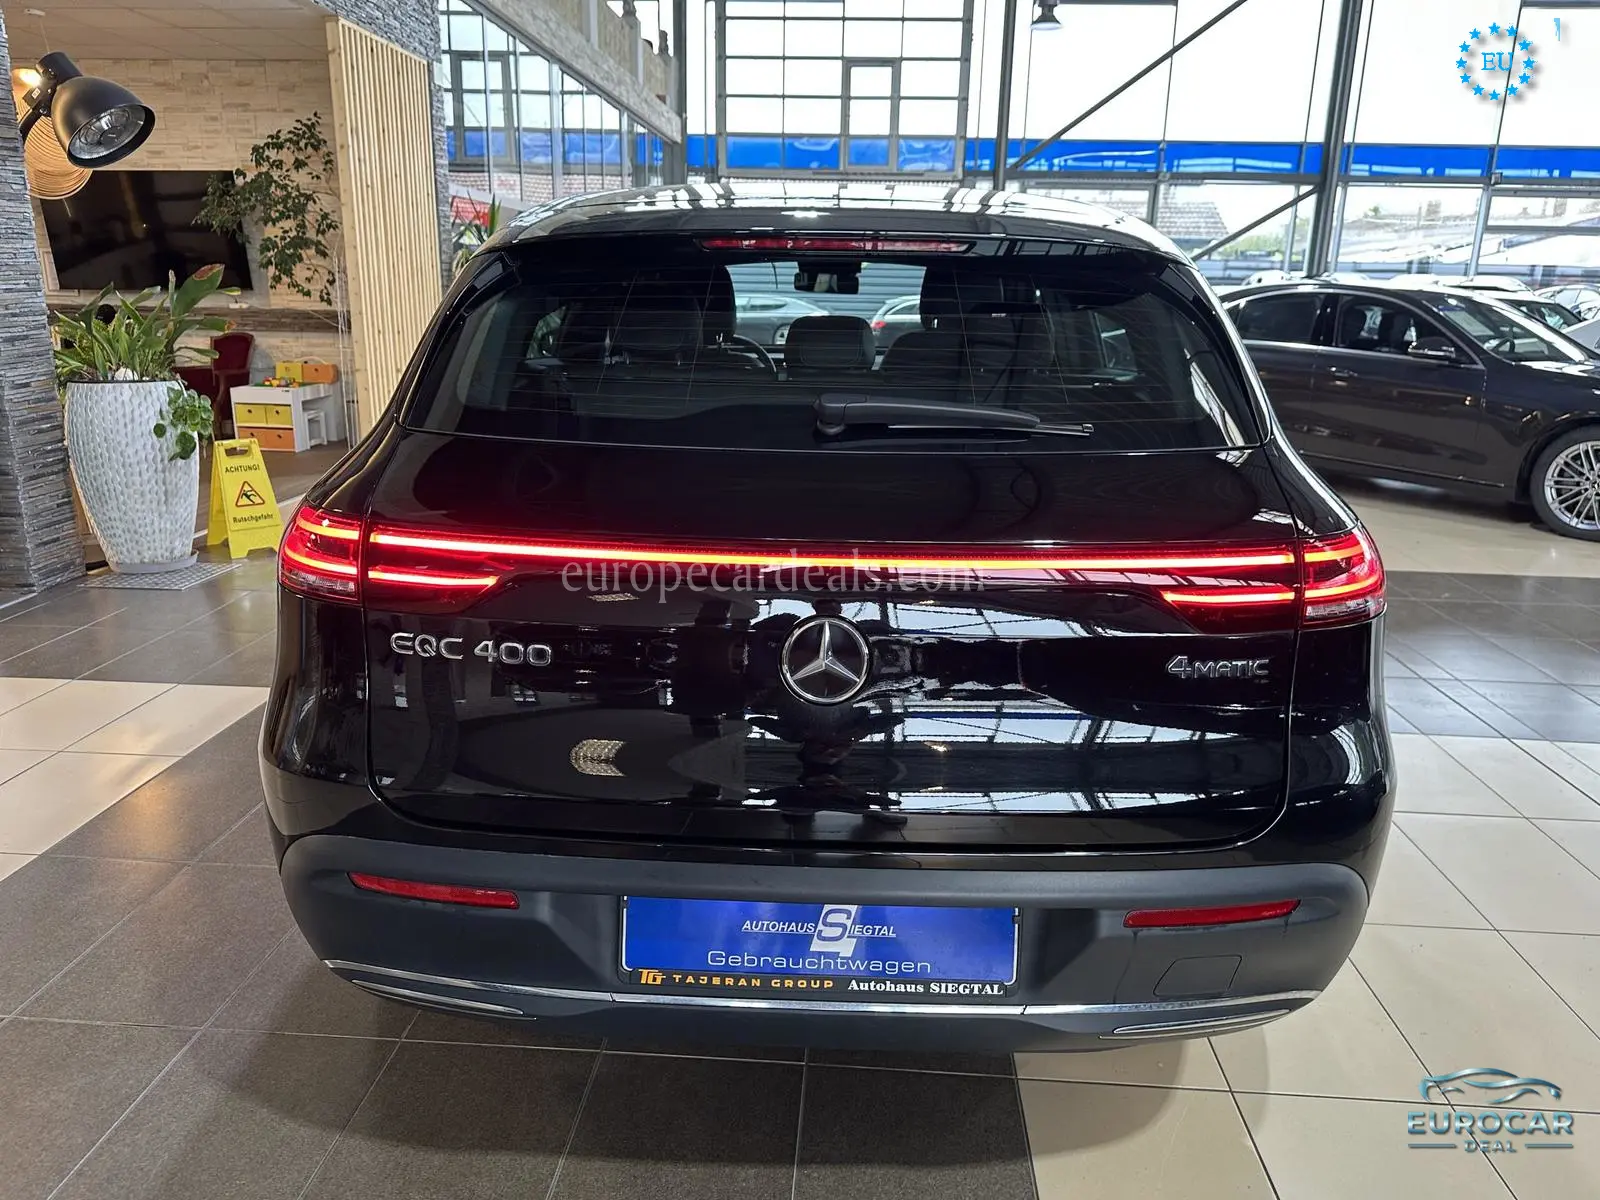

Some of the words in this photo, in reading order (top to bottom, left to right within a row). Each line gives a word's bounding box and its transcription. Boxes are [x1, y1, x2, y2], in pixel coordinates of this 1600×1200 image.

[225, 464, 260, 473] ACHTUNG!
[233, 514, 274, 523] Rutschgefahr
[390, 632, 464, 657] EQC
[473, 640, 552, 667] 400
[1166, 655, 1270, 679] 4MATIC
[742, 919, 815, 934] AUTOHAUS
[707, 950, 931, 975] Gebrauchtwagen
[673, 975, 761, 989] TAJERAN
[771, 978, 834, 989] GROUP
[848, 979, 925, 994] Autohaus
[929, 983, 1004, 996] SIEGTAL
